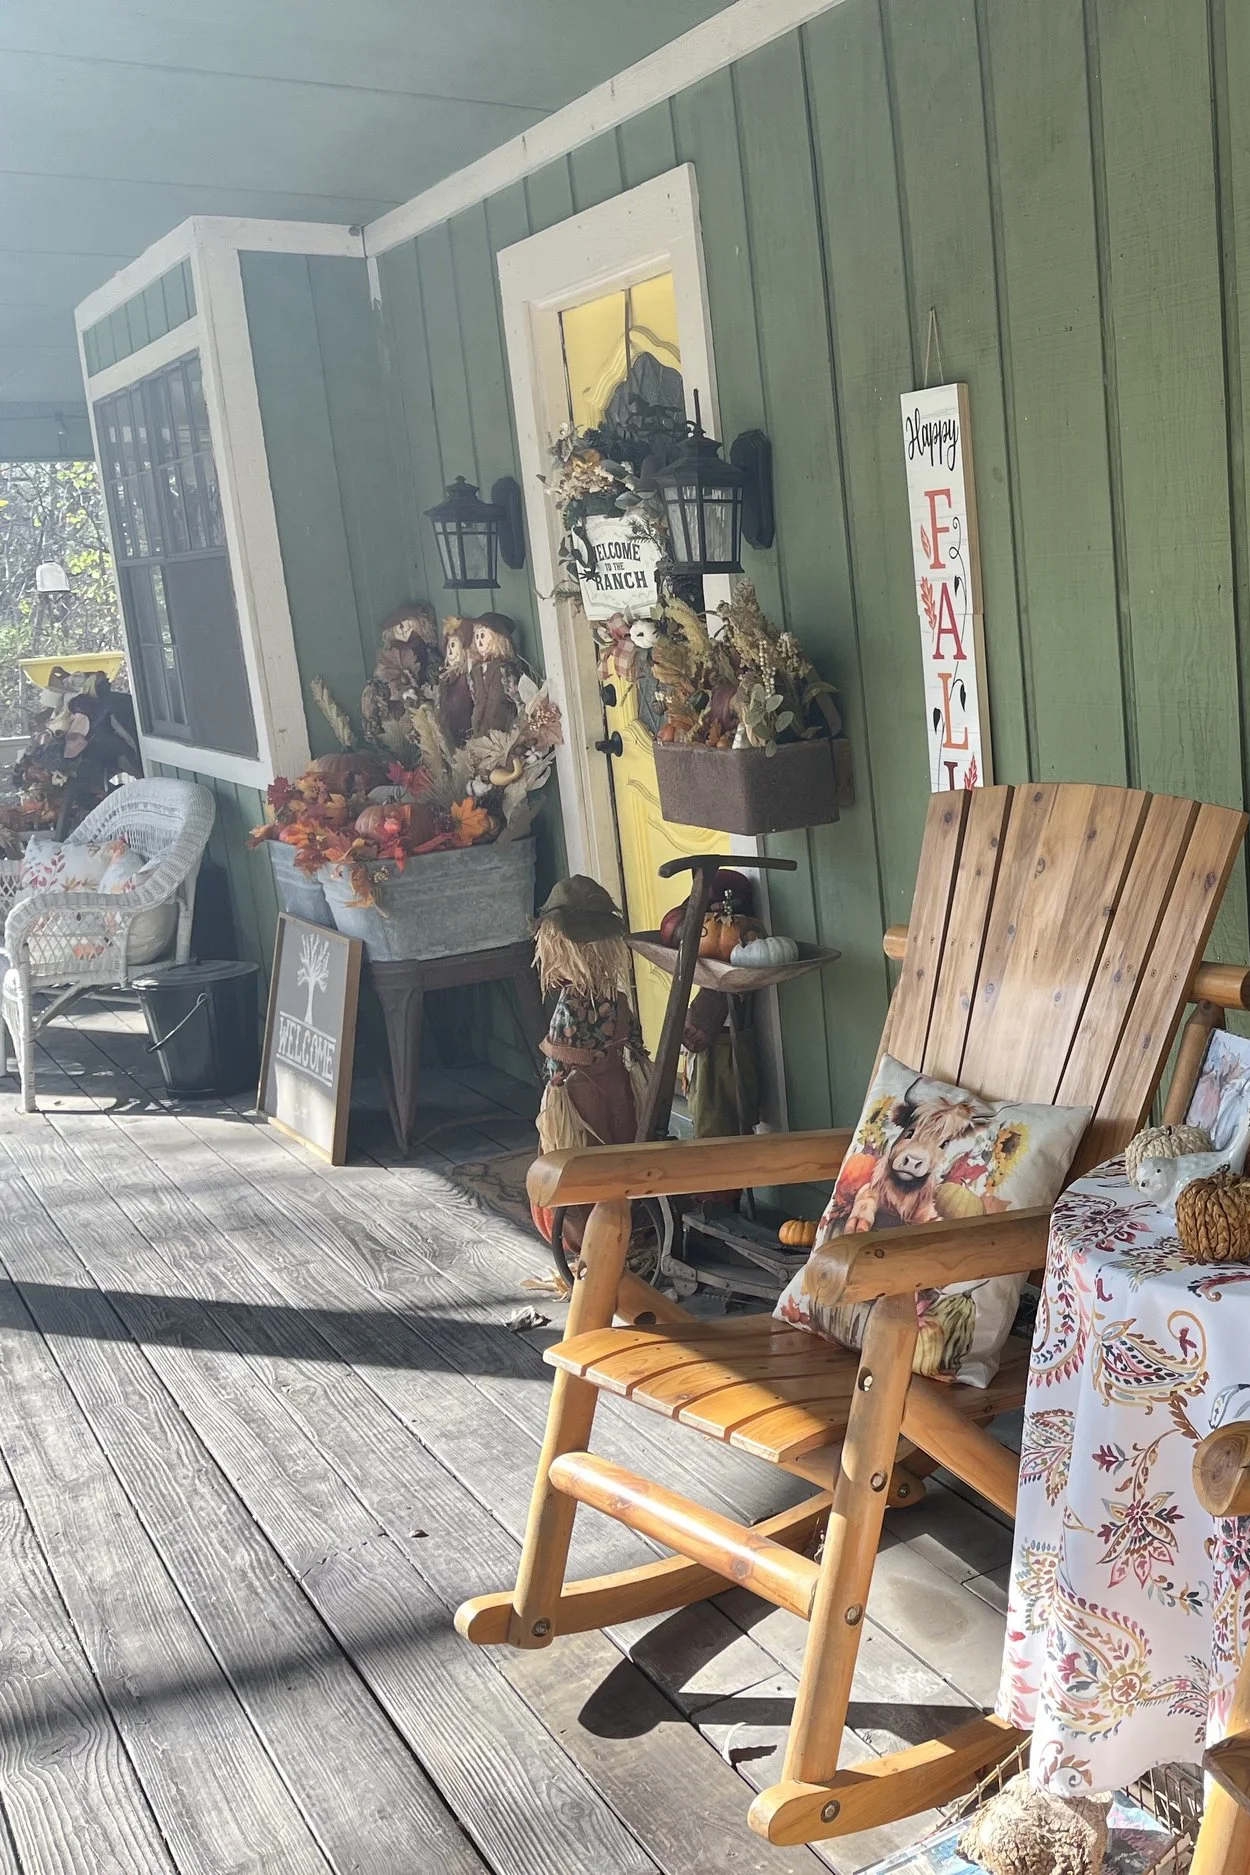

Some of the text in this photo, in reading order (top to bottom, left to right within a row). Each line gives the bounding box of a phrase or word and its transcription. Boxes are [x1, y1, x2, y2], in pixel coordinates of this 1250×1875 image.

[906, 408, 959, 471] Happy
[596, 571, 648, 590] RANCH
[604, 562, 625, 571] TO THE
[278, 1016, 336, 1082] WELCOME
